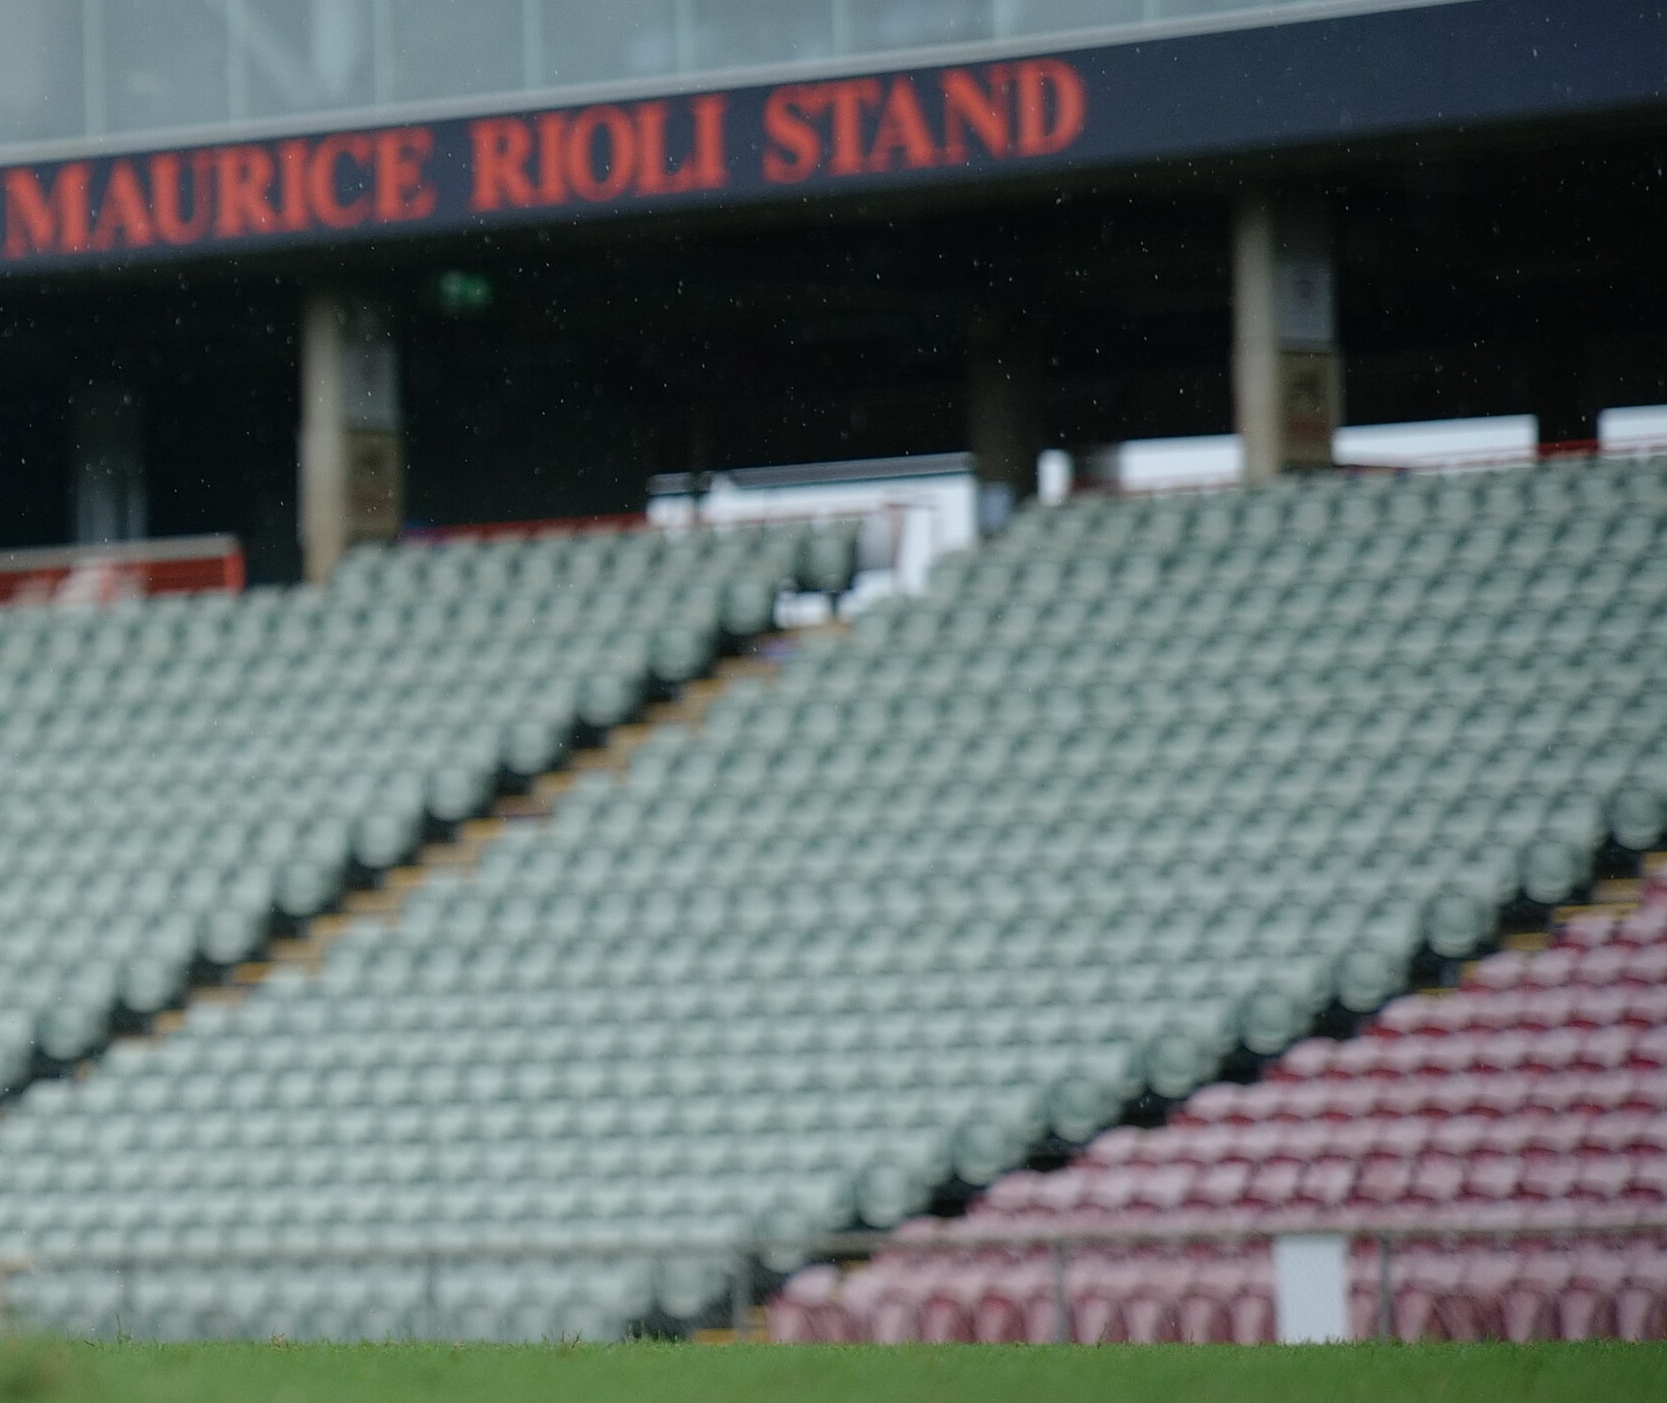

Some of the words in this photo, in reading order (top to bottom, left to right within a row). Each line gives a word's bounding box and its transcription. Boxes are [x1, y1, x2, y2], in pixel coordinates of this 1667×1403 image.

[2, 127, 436, 259] MAURICE
[470, 93, 730, 212] RIOLI
[760, 59, 1086, 185] STAND
